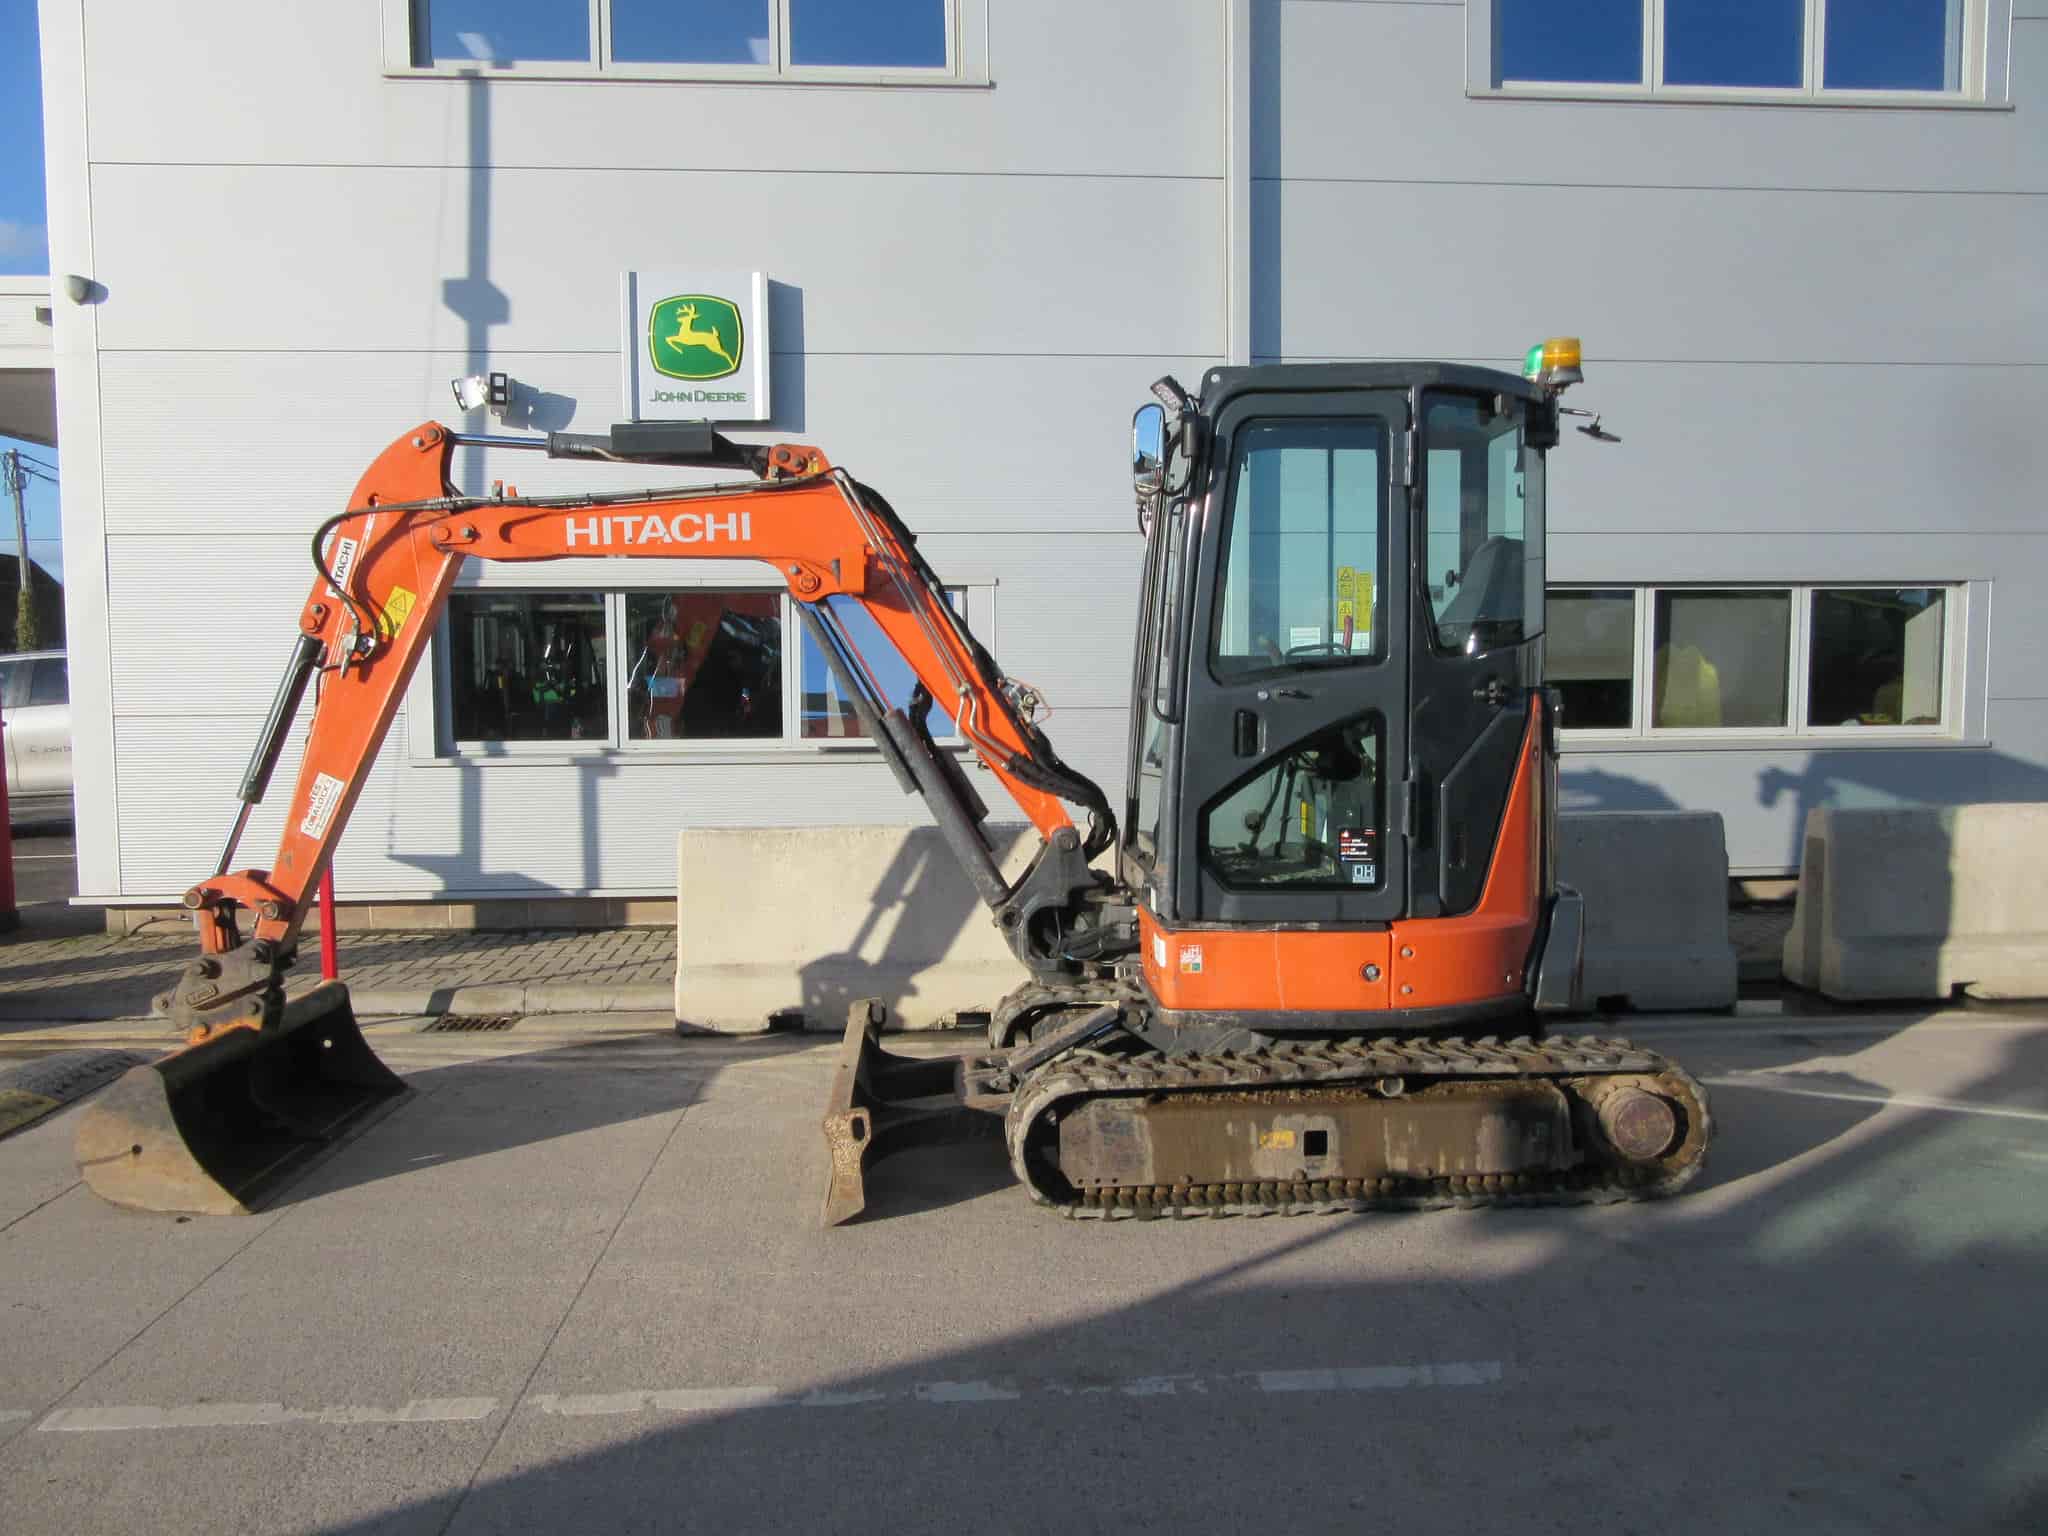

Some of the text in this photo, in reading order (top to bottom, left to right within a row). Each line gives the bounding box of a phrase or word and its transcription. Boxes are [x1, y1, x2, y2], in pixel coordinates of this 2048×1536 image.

[650, 389, 747, 402] JOHN DEERE
[565, 511, 752, 546] HITACHI
[332, 541, 353, 590] ITACHI
